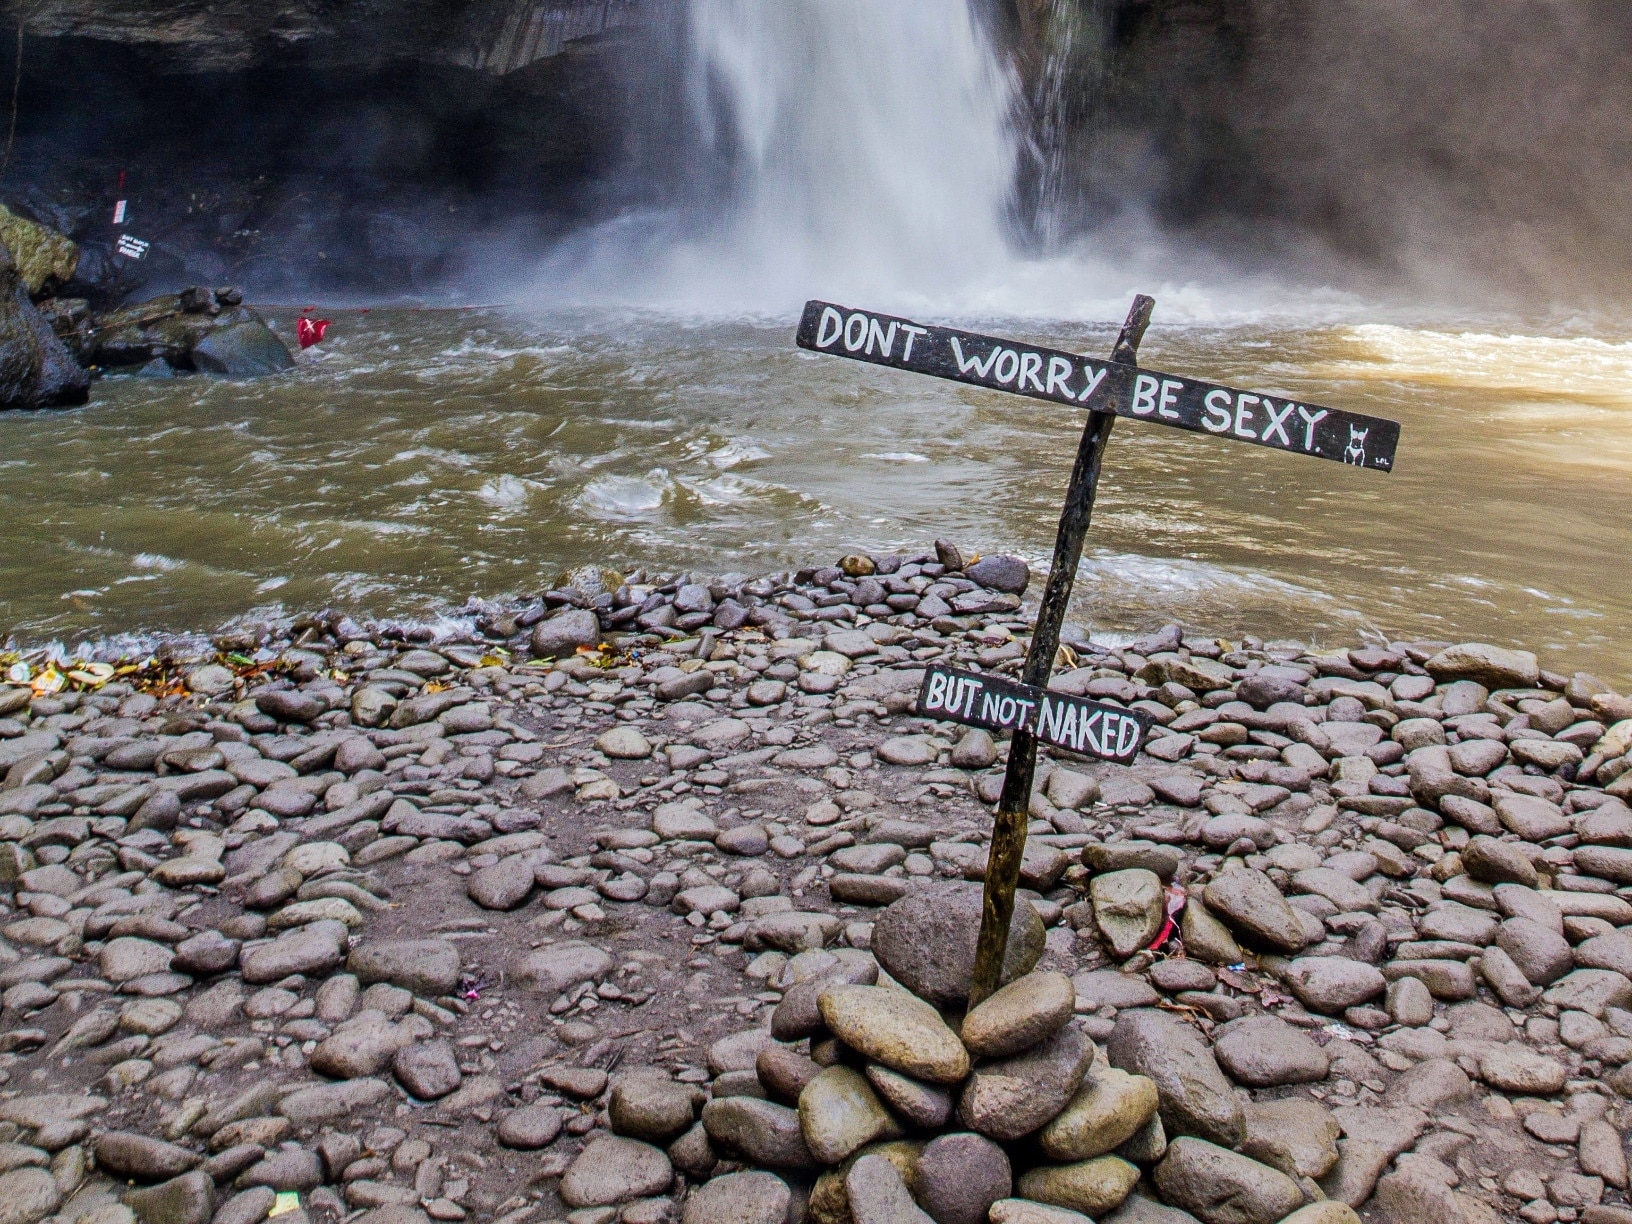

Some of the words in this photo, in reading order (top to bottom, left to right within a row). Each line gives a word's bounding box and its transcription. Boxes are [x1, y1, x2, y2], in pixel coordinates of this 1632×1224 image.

[816, 306, 927, 362] DON'T
[950, 336, 1107, 402] WORRY
[1131, 374, 1184, 419] BE
[925, 671, 983, 719] BUT
[981, 692, 1035, 730] NOT
[1036, 696, 1141, 758] NAKED
